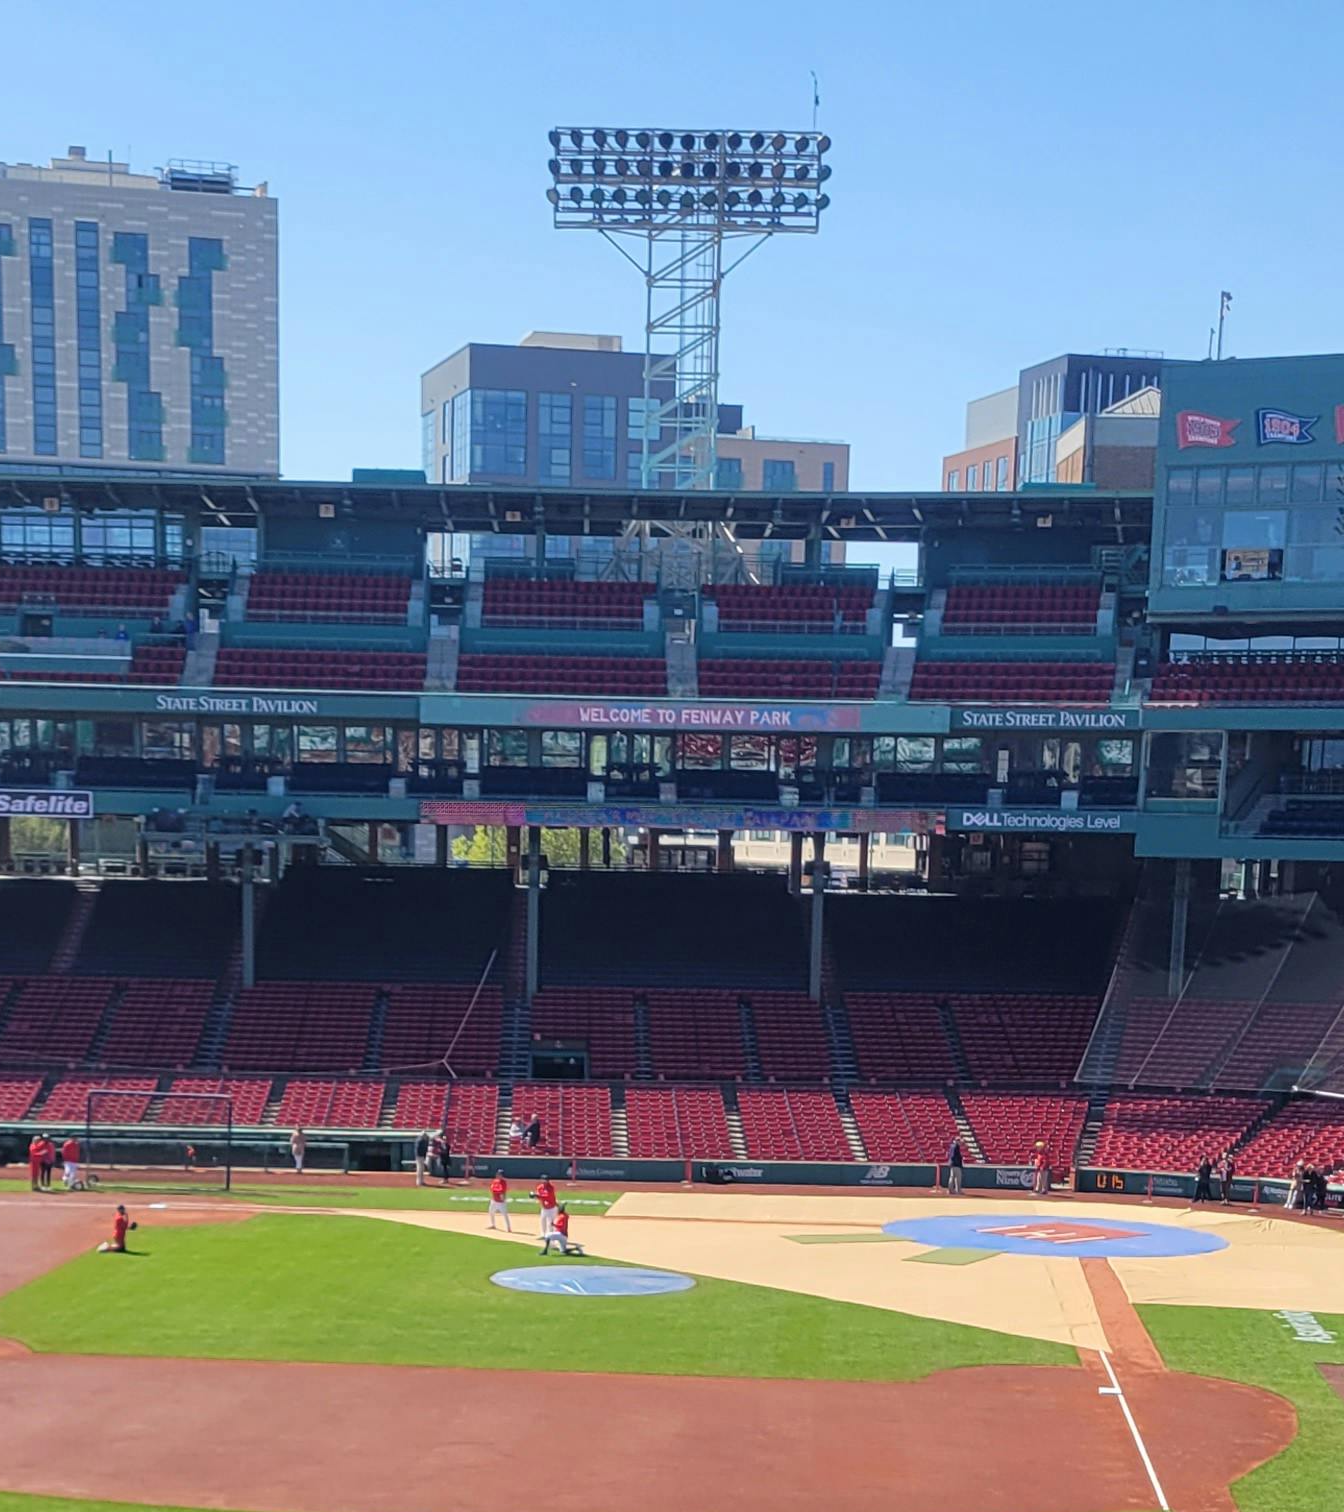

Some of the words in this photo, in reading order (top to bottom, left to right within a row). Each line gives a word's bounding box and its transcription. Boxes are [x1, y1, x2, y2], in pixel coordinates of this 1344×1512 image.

[157, 695, 199, 710] STATE
[199, 696, 249, 711] STREET
[253, 697, 317, 713] PAVILION
[580, 707, 651, 722] WELCOME
[658, 709, 676, 723] TO
[681, 710, 744, 725] FENWAY
[750, 711, 791, 726] PARK
[963, 711, 1003, 726] STATE
[1006, 711, 1056, 726] STREET
[1059, 712, 1126, 728] PAVILION
[962, 812, 1002, 827] DELL
[1001, 813, 1084, 831] Technologies
[1087, 814, 1120, 829] Level
